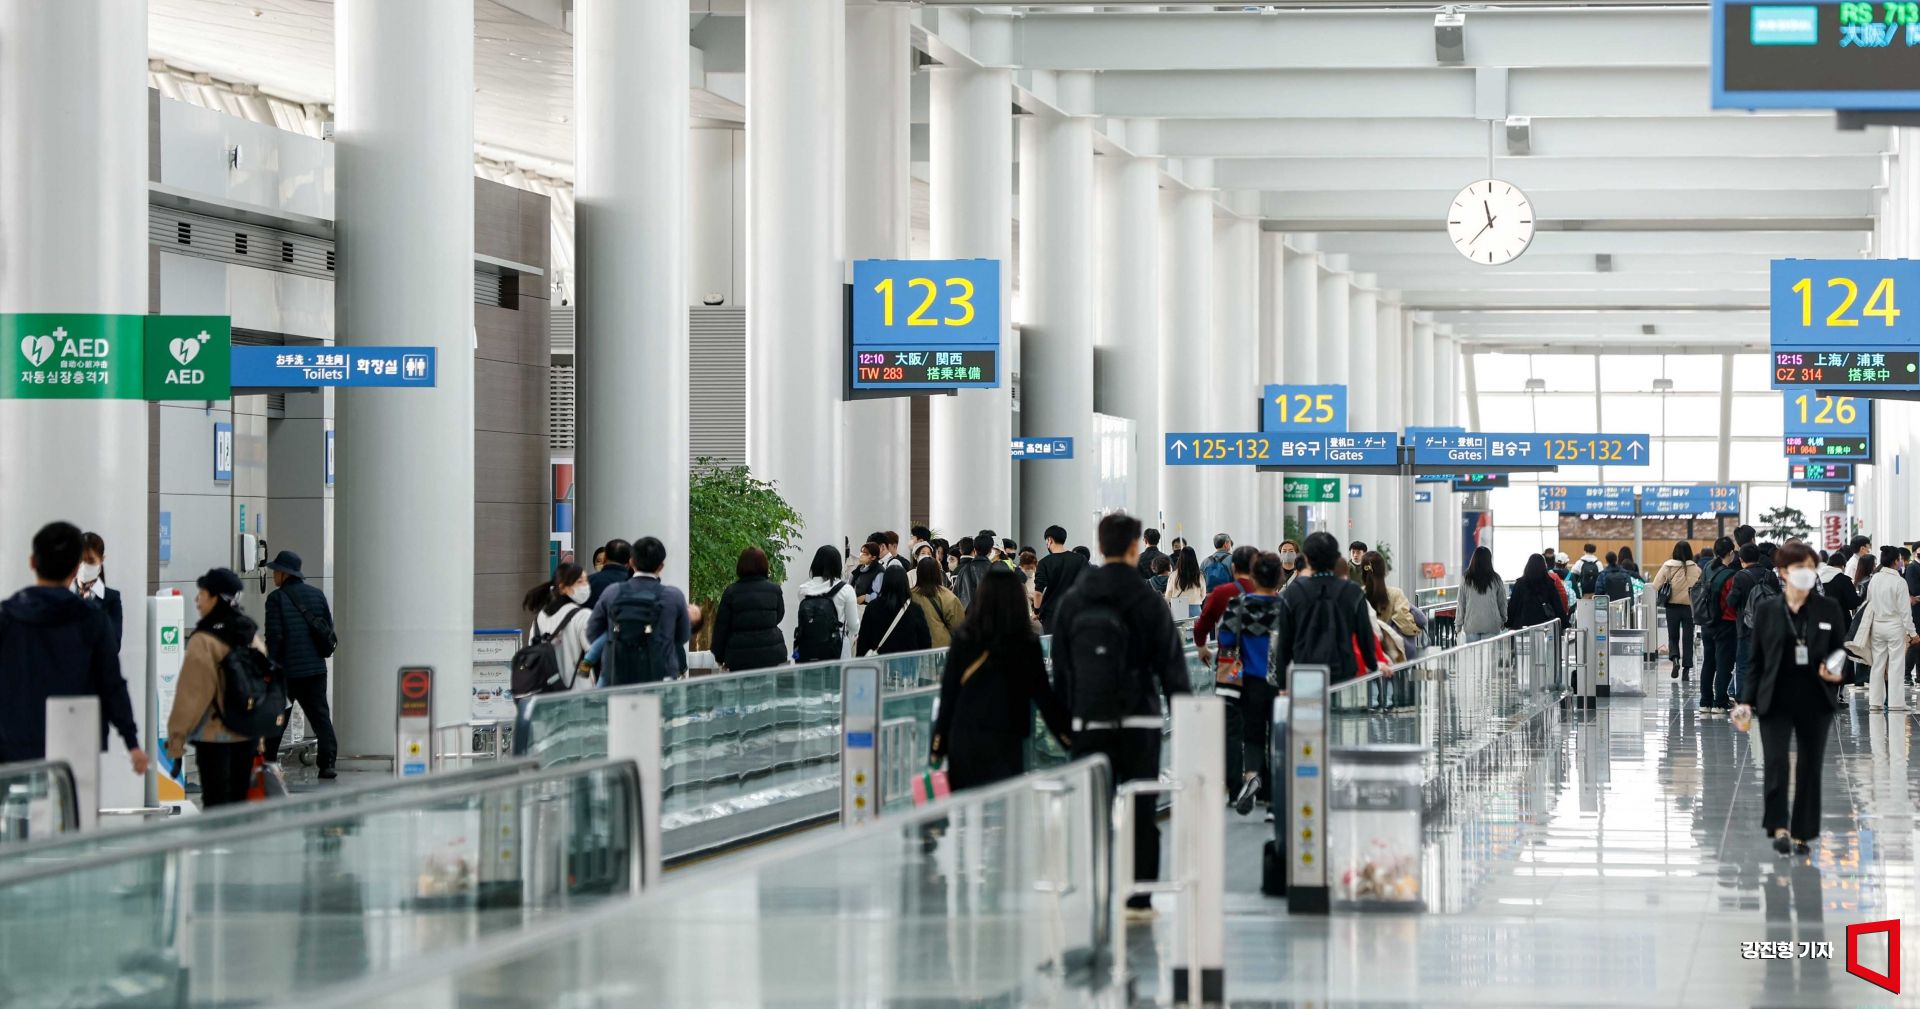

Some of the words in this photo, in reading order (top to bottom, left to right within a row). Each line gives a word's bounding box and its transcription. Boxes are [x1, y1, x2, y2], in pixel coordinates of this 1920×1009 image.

[1840, 2, 1873, 24] RS
[1883, 2, 1919, 24] 713
[874, 277, 975, 326] 123
[1792, 277, 1901, 327] 124
[61, 338, 109, 357] AED
[859, 354, 885, 364] 12:10
[1776, 354, 1803, 365] 12:15
[1857, 353, 1885, 366] 浦東
[303, 368, 343, 380] Toilets
[357, 359, 398, 375] 화장실
[859, 368, 880, 379] TW
[883, 368, 903, 380] 283
[927, 367, 981, 380] 搭乗準備
[1776, 368, 1796, 381] CZ
[1801, 368, 1823, 381] 314
[1848, 368, 1890, 381] 搭乗中
[21, 371, 109, 384] 자동심장충격기
[165, 370, 205, 384] AED
[1275, 394, 1335, 423] 125
[1795, 395, 1856, 424] 126
[1193, 439, 1270, 459] 125-132
[1282, 442, 1320, 457] 탑승구
[1330, 449, 1364, 461] Gates
[1448, 449, 1482, 460] Gates
[1491, 441, 1531, 457] 탑승구
[1544, 440, 1622, 460] 125-132
